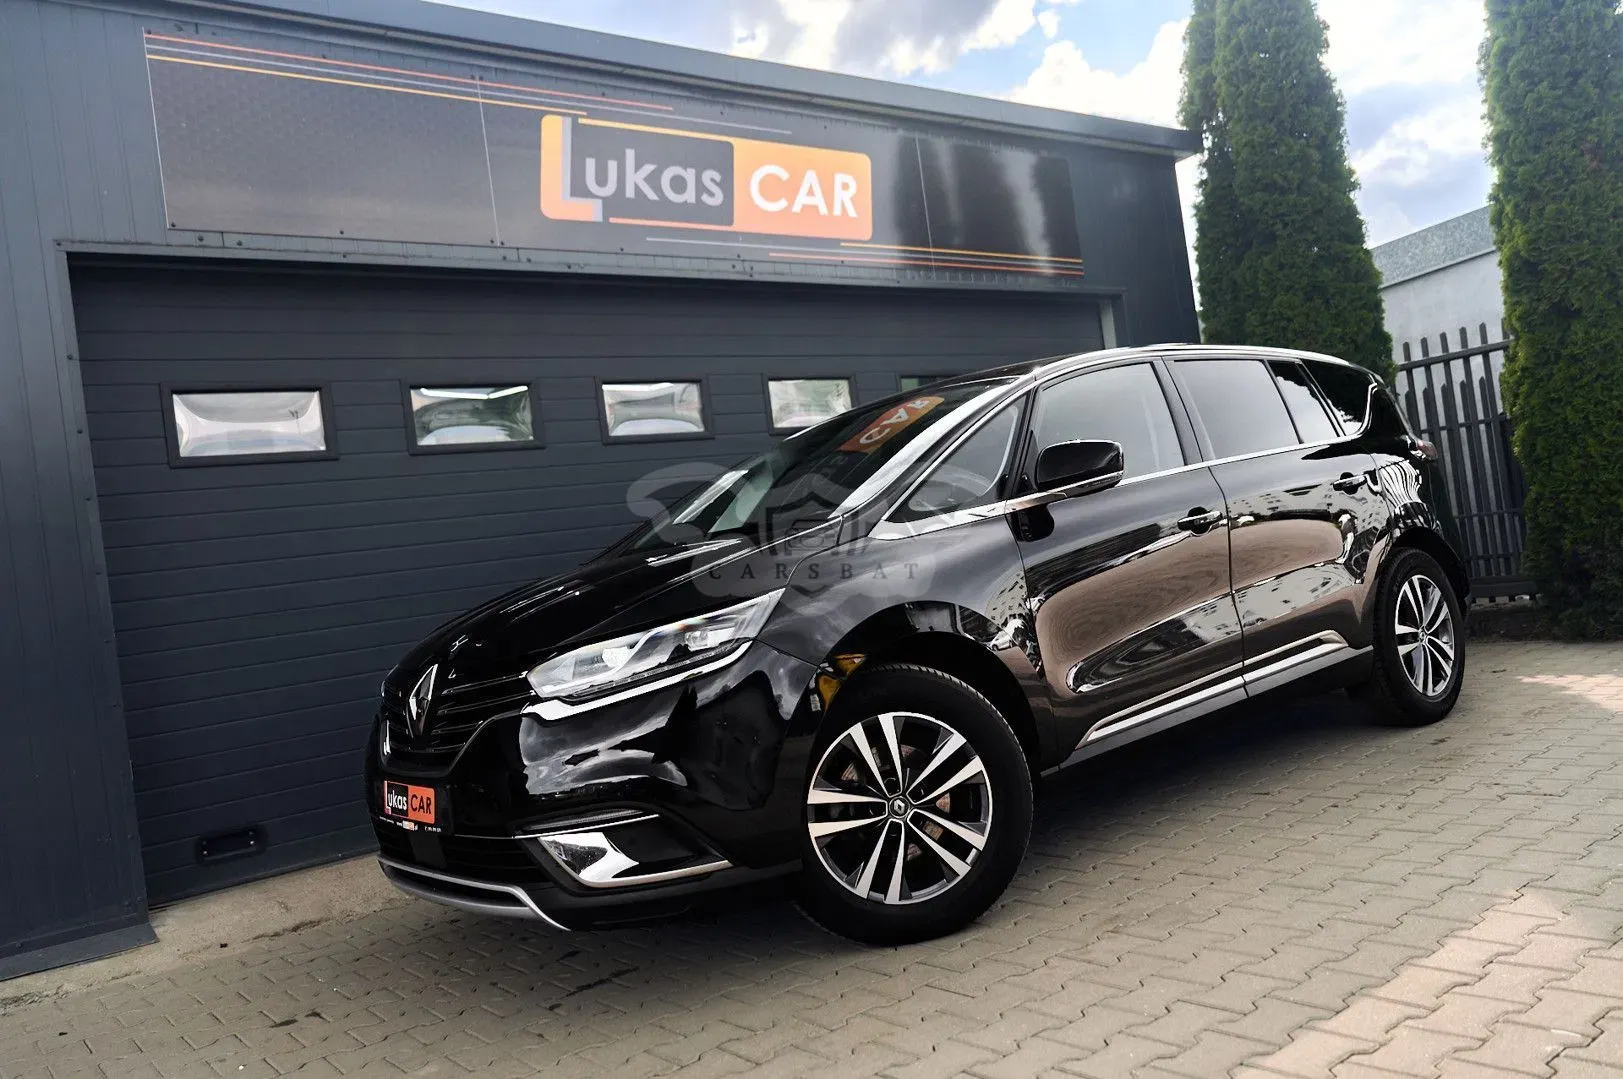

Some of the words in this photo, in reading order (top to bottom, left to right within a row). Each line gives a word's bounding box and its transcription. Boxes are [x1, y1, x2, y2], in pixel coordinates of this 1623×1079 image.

[541, 115, 724, 222] Lukas
[750, 164, 858, 218] CAR
[384, 780, 408, 815] Lukas
[410, 793, 432, 814] CAR
